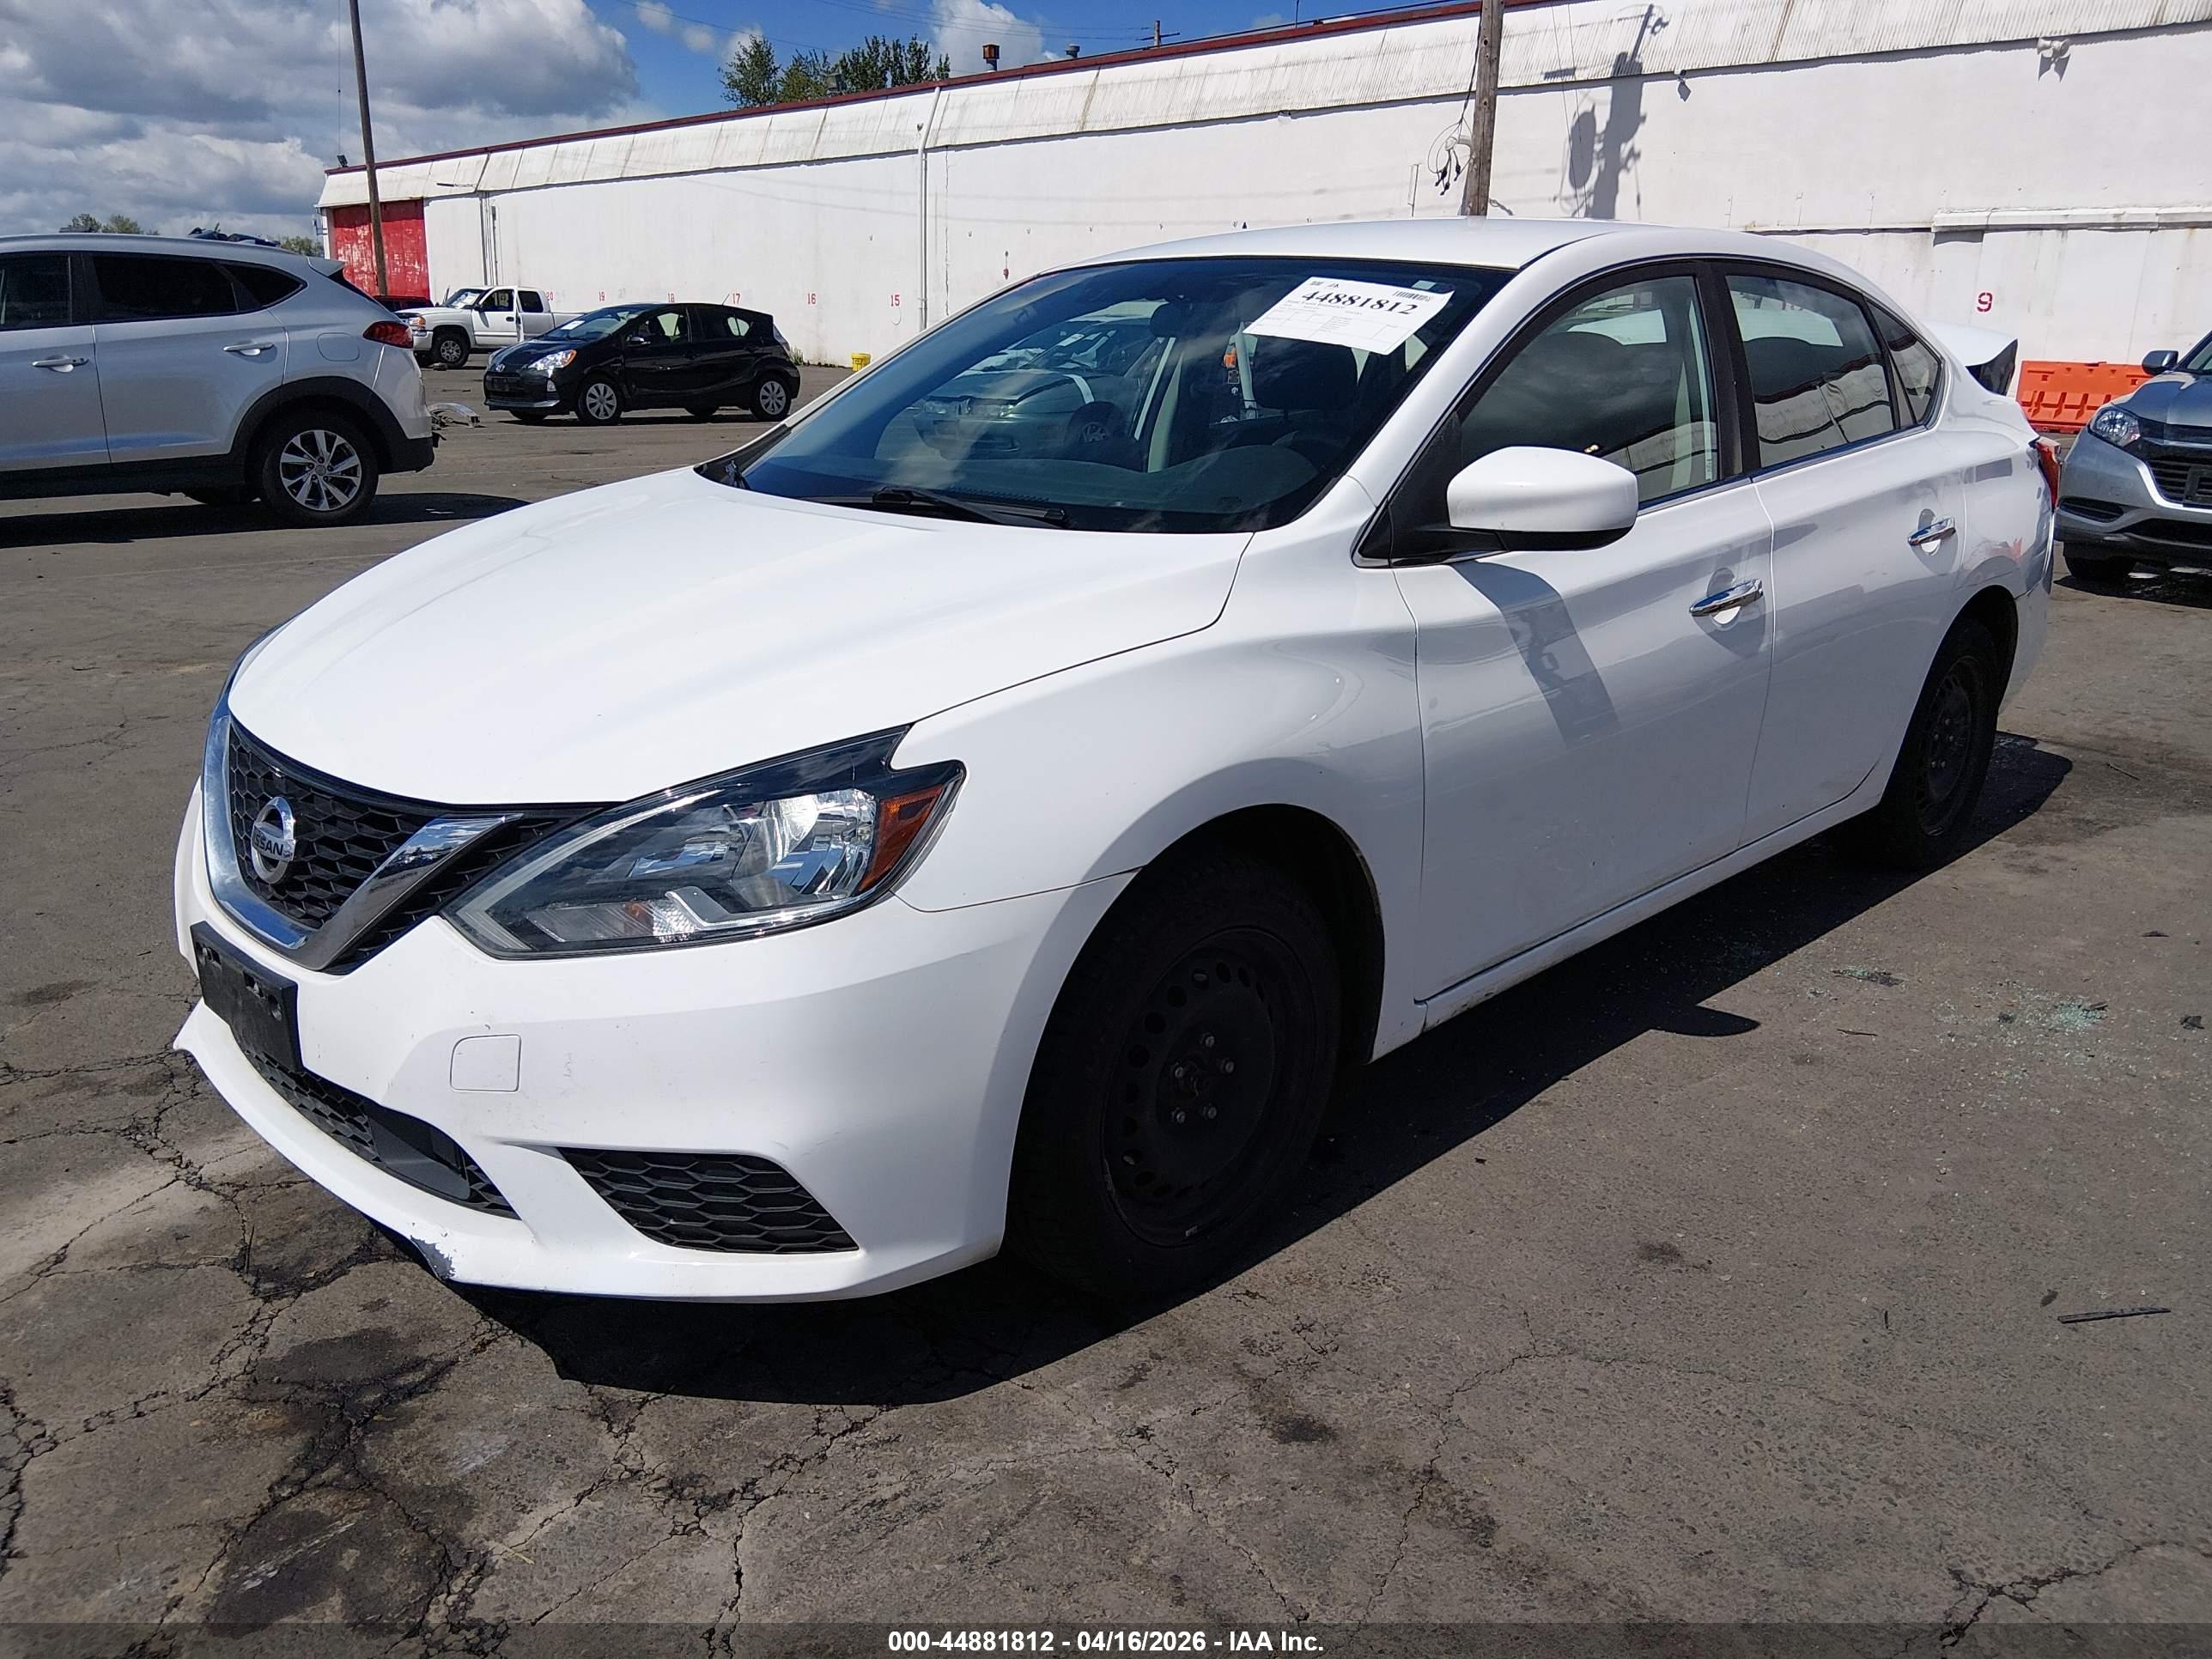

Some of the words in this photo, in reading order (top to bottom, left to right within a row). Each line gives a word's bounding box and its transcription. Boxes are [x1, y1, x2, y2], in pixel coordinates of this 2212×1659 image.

[546, 291, 554, 301] 20
[599, 291, 605, 301] 19
[667, 293, 675, 303] 18
[732, 293, 741, 304] 17
[807, 293, 817, 305] 16
[890, 295, 901, 307] 15
[1301, 290, 1419, 315] 44881812
[1977, 292, 1993, 313] 9
[253, 830, 284, 856] SSAN
